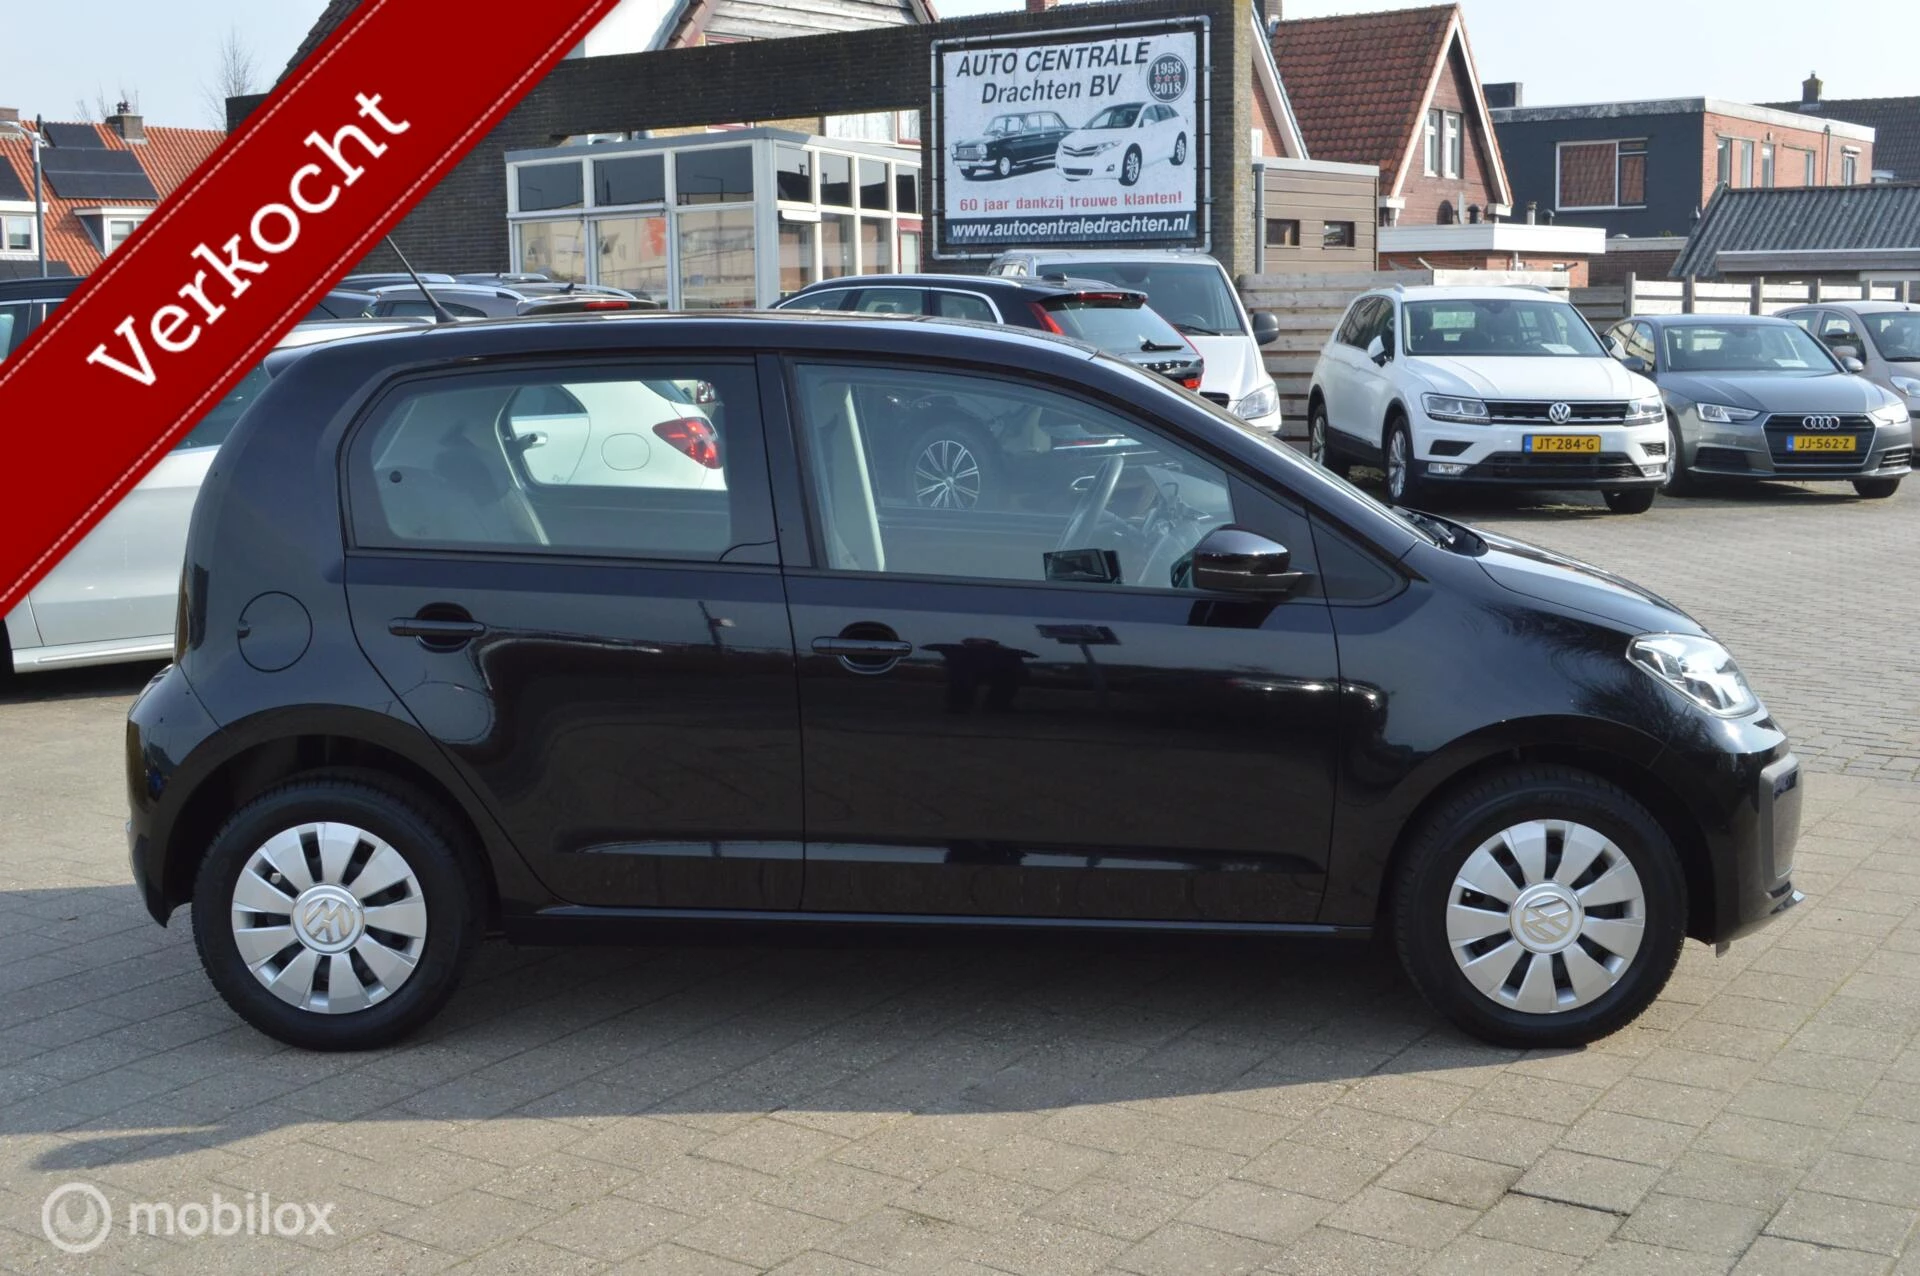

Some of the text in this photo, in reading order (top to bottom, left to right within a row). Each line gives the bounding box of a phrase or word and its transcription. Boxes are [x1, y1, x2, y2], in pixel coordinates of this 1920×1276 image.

[956, 41, 1151, 77] AUTO CENTRALE
[1154, 60, 1182, 75] 1958
[981, 73, 1122, 104] Drachten BV
[1153, 81, 1182, 95] 2018
[960, 191, 1183, 212] 60 jaar dankzij trouwe klanten!
[952, 213, 1190, 237] www.autocentraledrachten.nl
[1536, 438, 1594, 450] JT-284-G
[1799, 438, 1850, 449] JJ-562-Z
